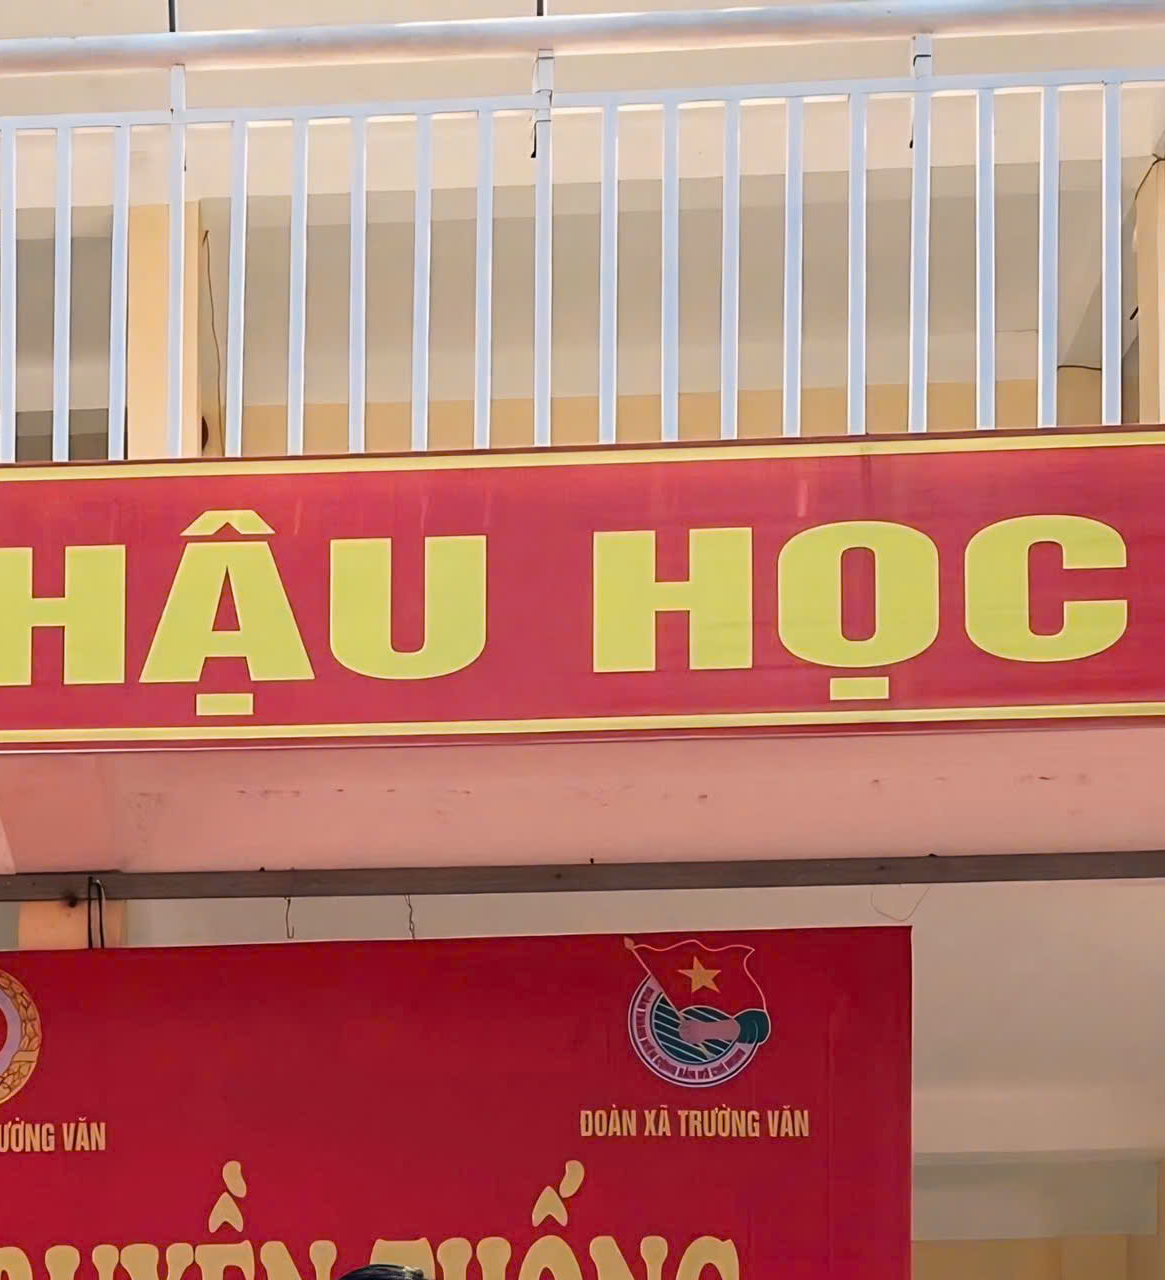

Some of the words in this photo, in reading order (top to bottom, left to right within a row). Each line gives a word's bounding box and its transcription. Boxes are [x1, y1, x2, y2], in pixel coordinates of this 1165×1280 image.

[593, 514, 1128, 701] HỌC
[62, 1116, 106, 1151] VĂN
[580, 1104, 637, 1137] ĐOÀN
[644, 1104, 671, 1137] XÃ
[678, 1103, 760, 1138] TRƯỜNG
[767, 1105, 810, 1138] VĂN
